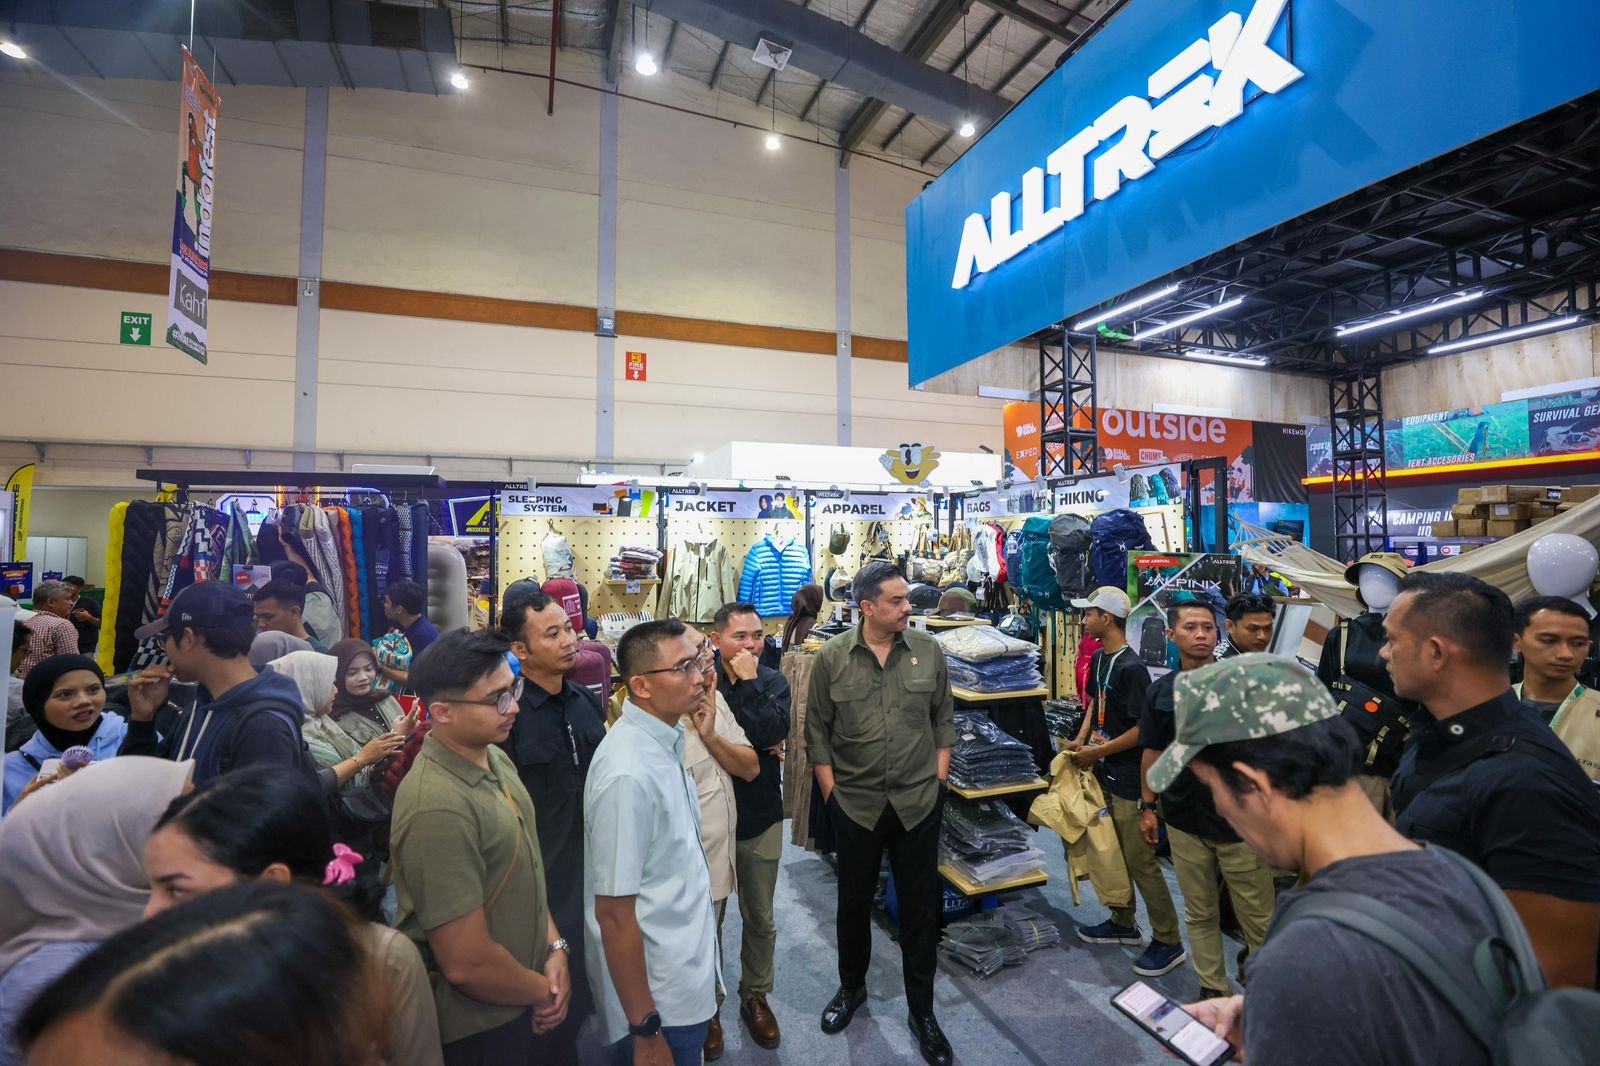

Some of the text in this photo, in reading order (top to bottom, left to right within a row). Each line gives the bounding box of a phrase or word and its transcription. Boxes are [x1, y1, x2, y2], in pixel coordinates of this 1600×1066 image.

[179, 282, 207, 319] Kahf
[123, 315, 150, 325] EXIT
[1405, 411, 1449, 426] EQUIPMENT
[1532, 407, 1581, 424] SURVIVAL
[1015, 447, 1038, 460] EXPED
[1140, 450, 1162, 461] CHUMS
[1407, 453, 1476, 469] TENT ACCESORIES
[504, 483, 529, 491] ALLTRE
[508, 495, 563, 504] SLEEPING
[1059, 489, 1105, 506] HIKING
[523, 504, 568, 513] SYSTEM
[675, 500, 737, 513] JACKET
[822, 504, 886, 515] APPAREL
[967, 501, 991, 513] BAGS
[1392, 510, 1442, 526] CAMPING
